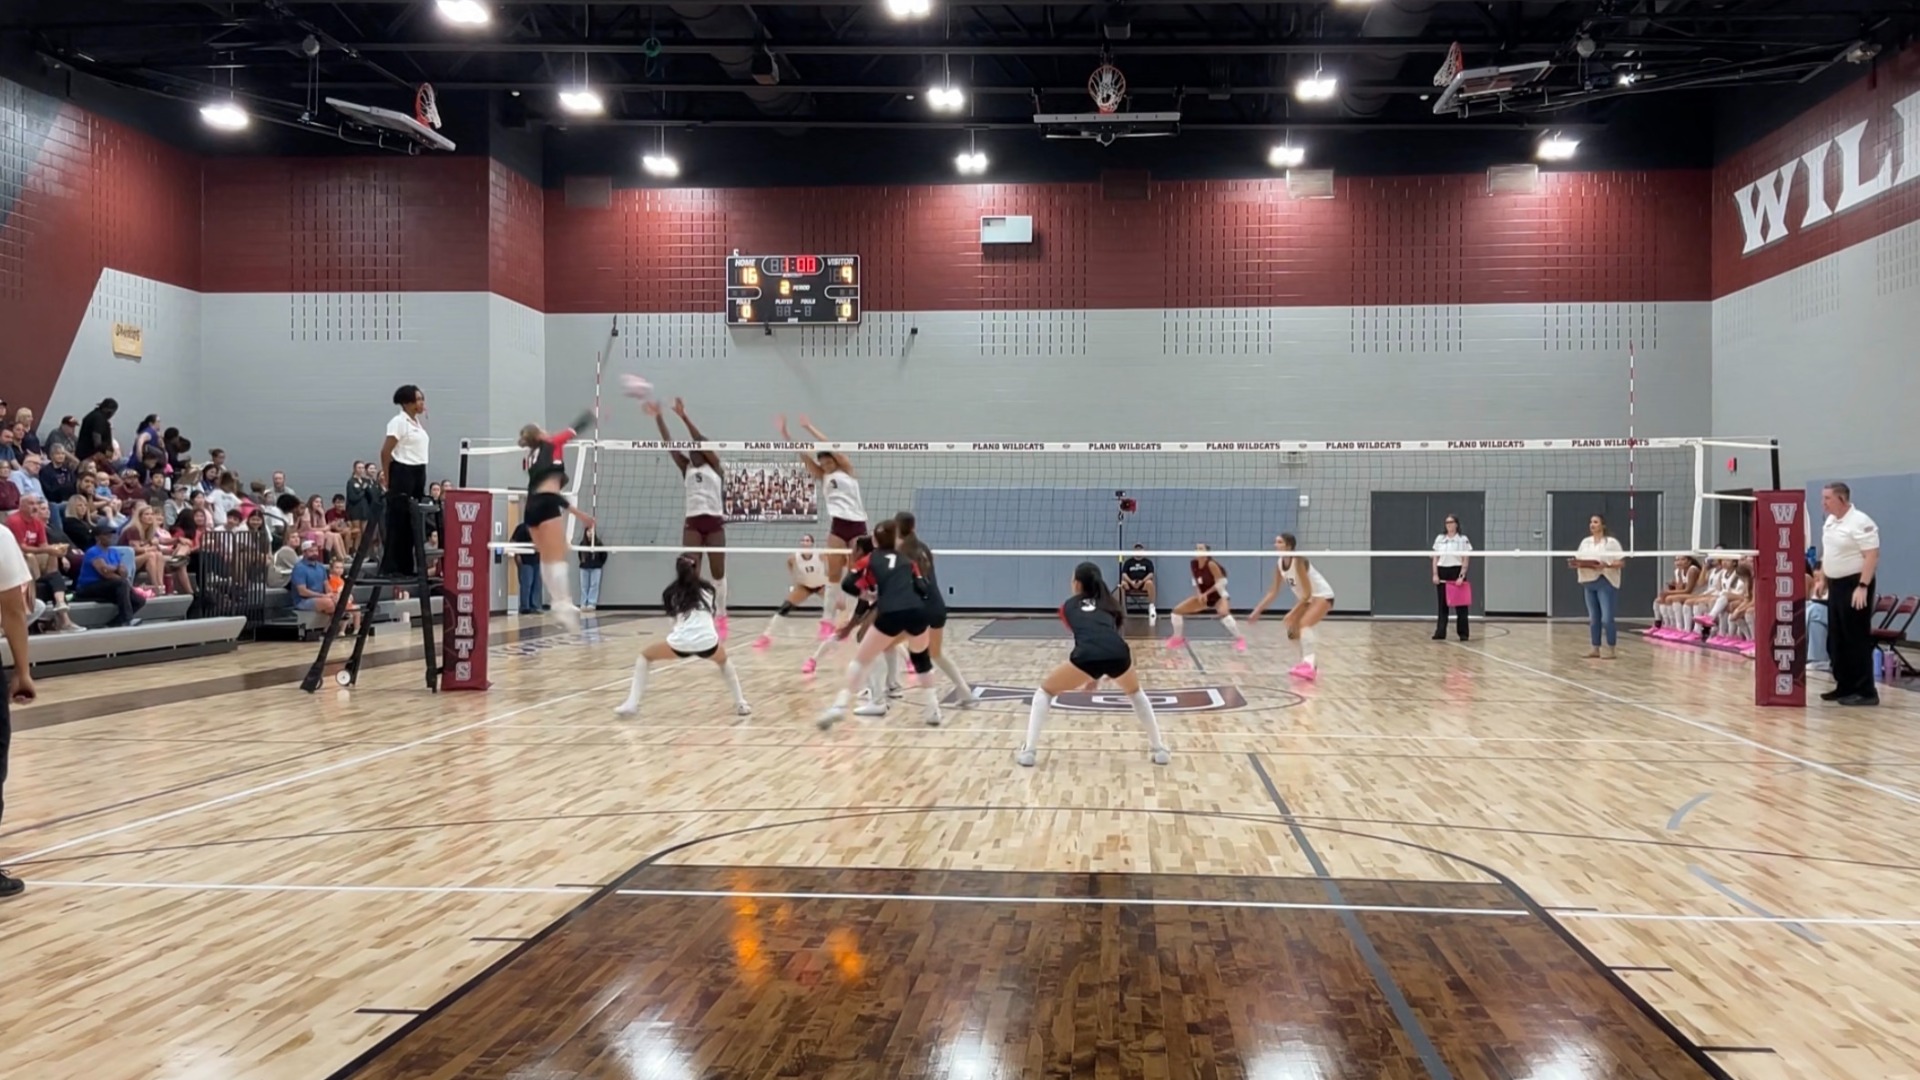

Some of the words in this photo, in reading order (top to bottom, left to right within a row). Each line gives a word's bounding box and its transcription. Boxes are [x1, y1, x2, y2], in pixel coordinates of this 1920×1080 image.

[735, 258, 756, 267] HOME
[827, 258, 854, 266] VISITOR
[742, 267, 758, 285] 16
[632, 441, 659, 449] PLANO
[661, 441, 701, 449] WILDCATS
[744, 442, 771, 450] PLANO
[773, 442, 815, 450] WILDCATS
[1479, 440, 1525, 448] WILDCATS
[455, 502, 480, 681] WILDCATS
[1770, 503, 1798, 695] WILDCATS
